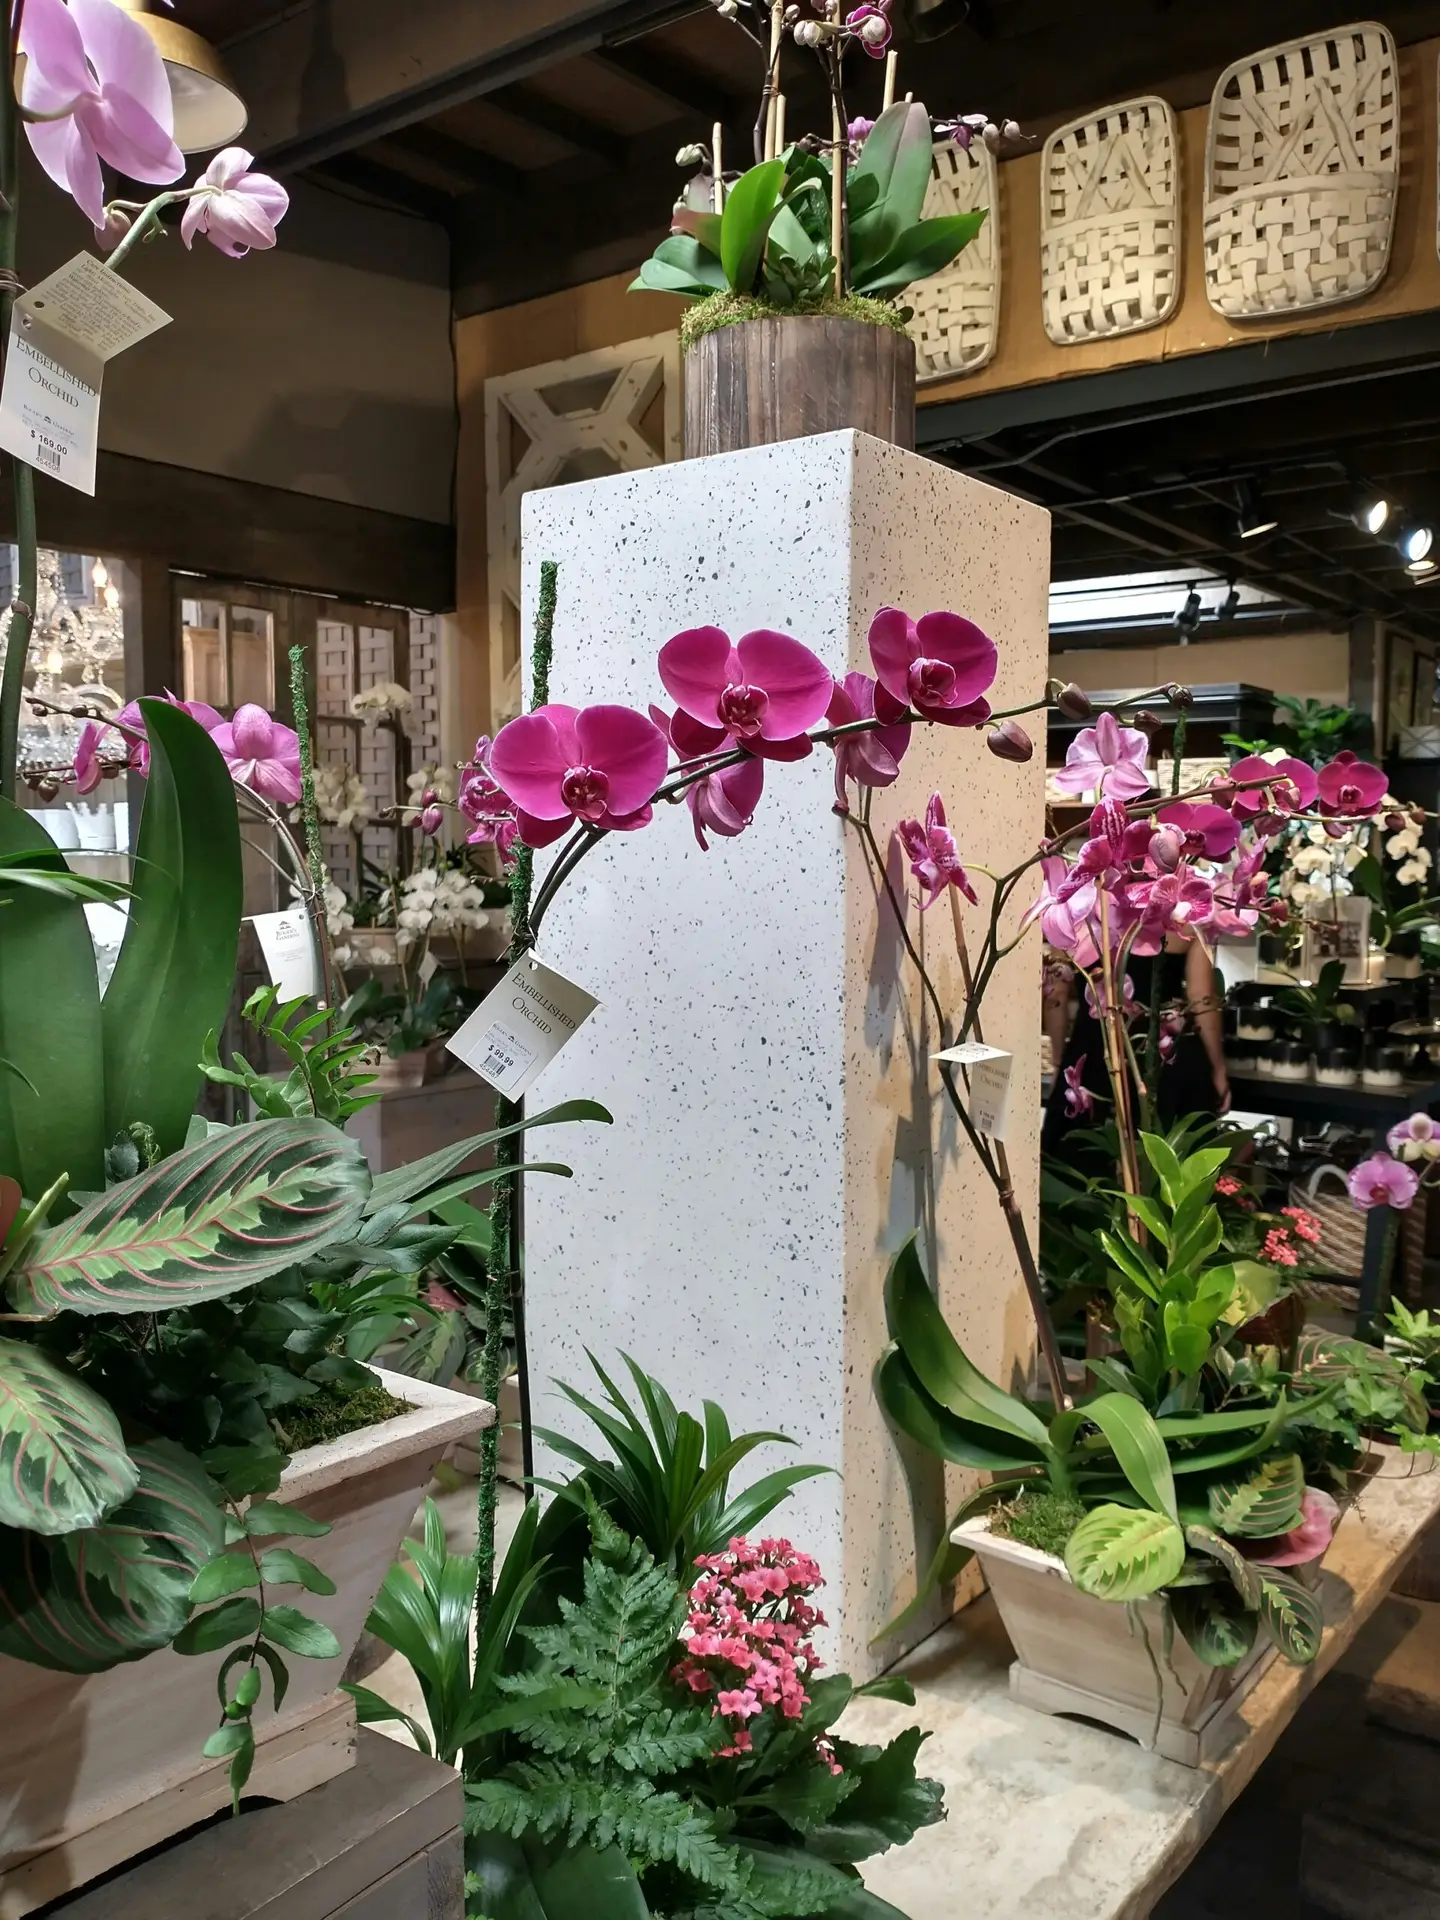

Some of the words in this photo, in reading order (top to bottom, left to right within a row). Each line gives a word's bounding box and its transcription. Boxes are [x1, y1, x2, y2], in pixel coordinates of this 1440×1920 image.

[16, 335, 96, 398] EMBELLISHED
[28, 367, 79, 408] ORCHID
[30, 429, 36, 438] $
[39, 435, 68, 455] 169.00
[512, 972, 576, 1030] EMBELLISHED
[512, 996, 552, 1035] ORCHID
[494, 1049, 515, 1067] 99.99
